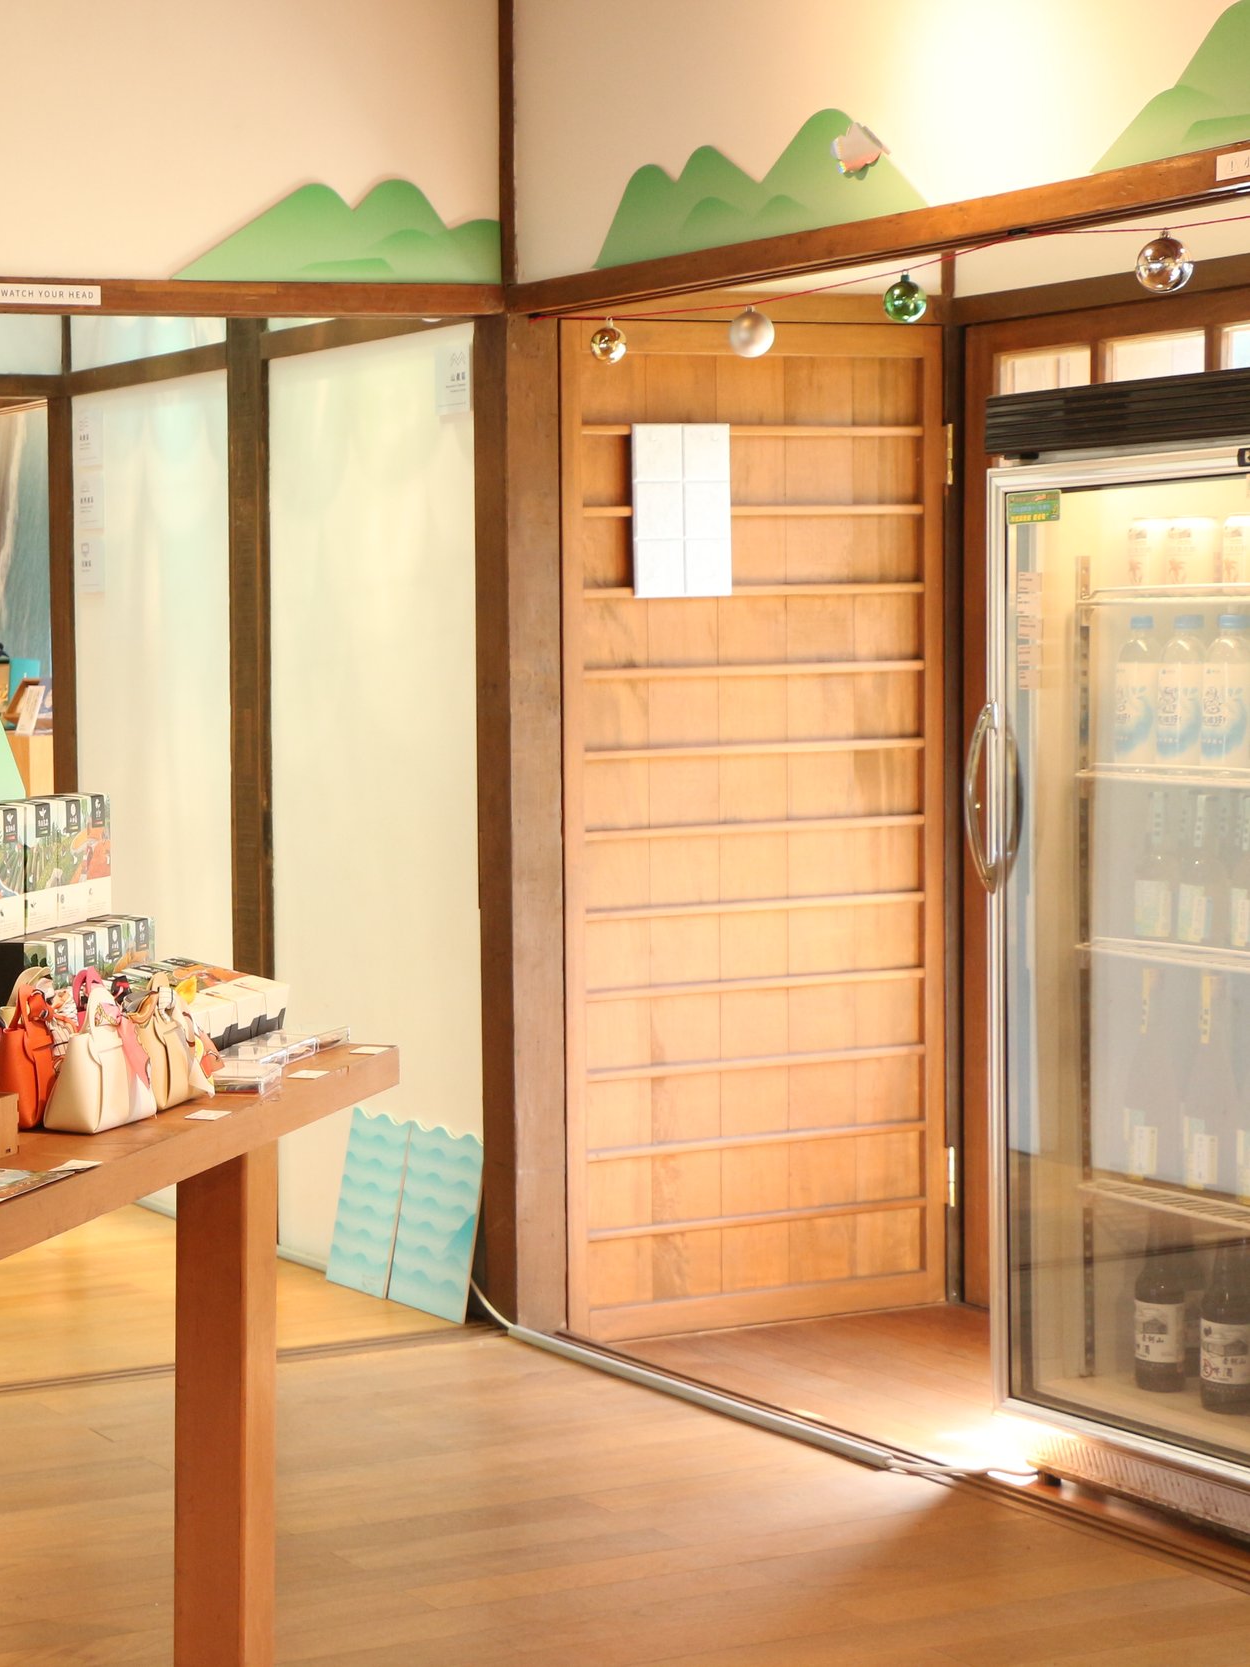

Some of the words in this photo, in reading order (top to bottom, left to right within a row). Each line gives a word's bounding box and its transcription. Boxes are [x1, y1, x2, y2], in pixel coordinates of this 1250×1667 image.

[1, 289, 34, 298] WATCH
[38, 290, 64, 299] YOUR
[68, 290, 94, 300] HEAD
